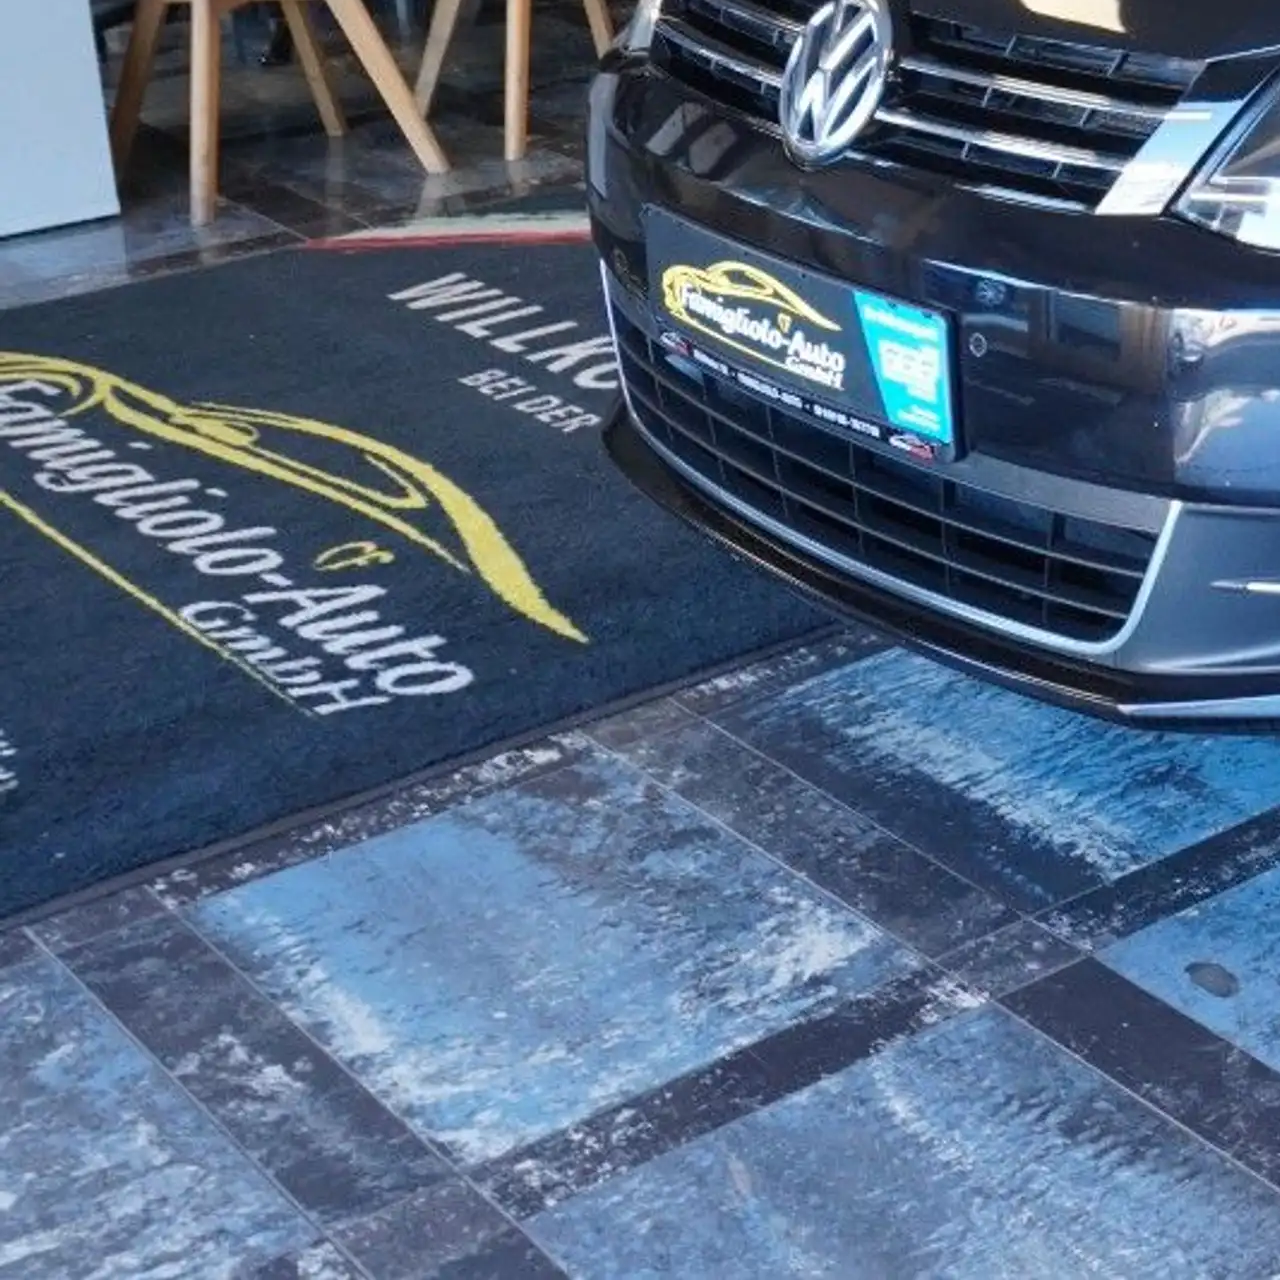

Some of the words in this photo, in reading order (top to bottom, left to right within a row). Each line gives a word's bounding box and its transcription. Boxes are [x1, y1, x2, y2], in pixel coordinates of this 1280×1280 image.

[457, 368, 537, 401] BEI
[512, 395, 602, 433] DER
[178, 601, 395, 716] GmbH
